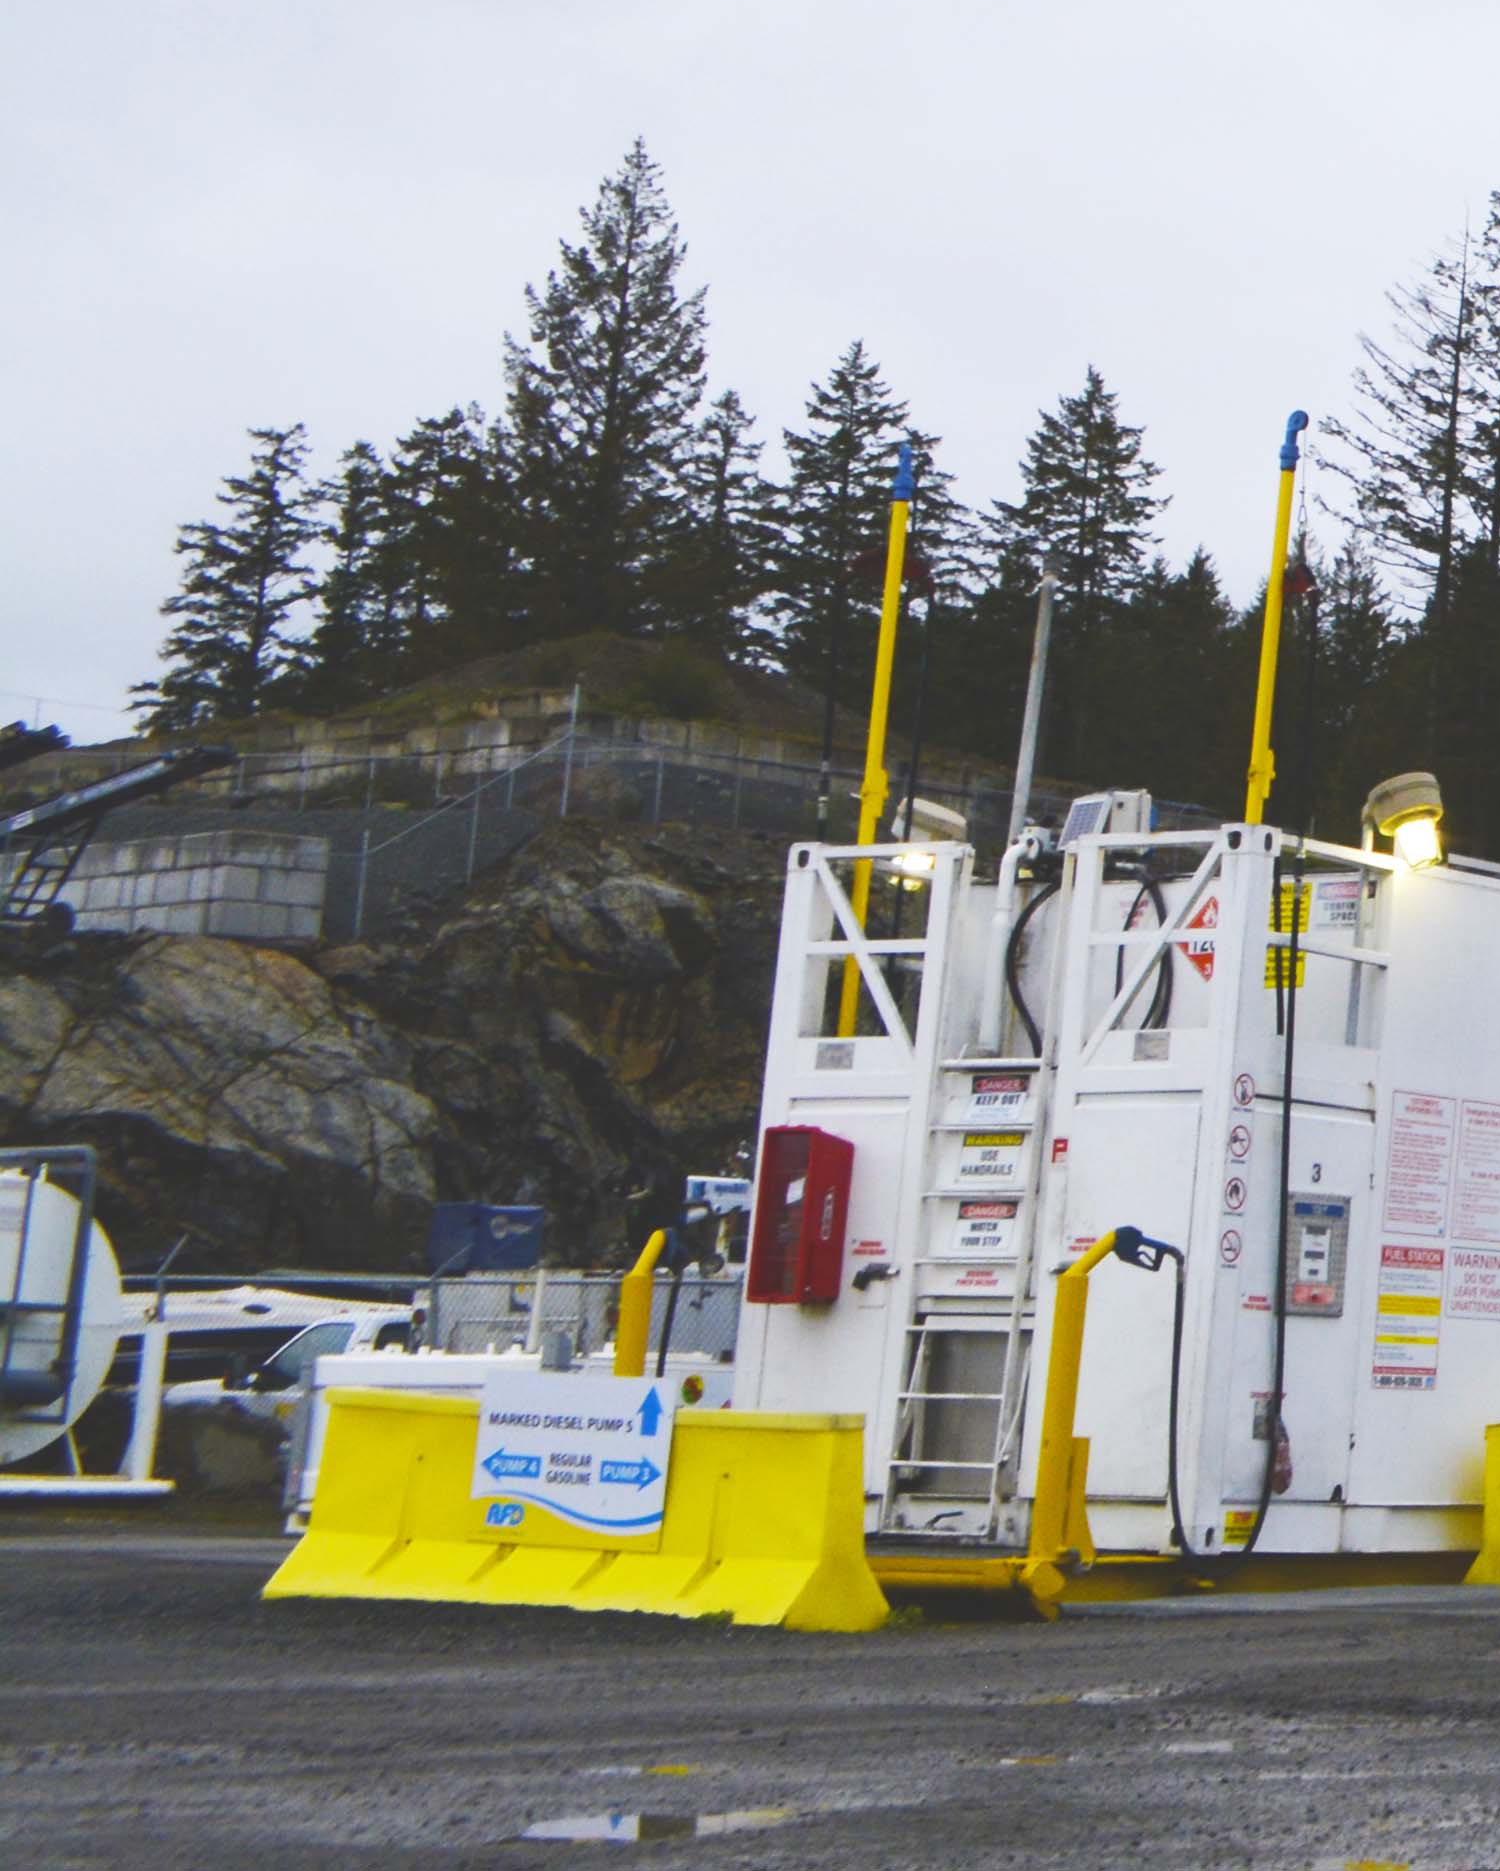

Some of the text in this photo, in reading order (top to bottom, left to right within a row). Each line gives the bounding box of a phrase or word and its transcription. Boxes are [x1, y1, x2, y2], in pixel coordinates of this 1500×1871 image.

[975, 1094, 1021, 1105] KEEP OUT
[980, 1150, 999, 1162] USE
[960, 1164, 1013, 1176] HANDRAILS
[1312, 1163, 1322, 1183] 3
[961, 1236, 1001, 1246] YOUR STEP
[489, 1413, 541, 1428] MARKED
[543, 1415, 584, 1430] DIESEL
[587, 1416, 622, 1432] PUMP
[490, 1459, 538, 1473] PUMP 4
[549, 1453, 592, 1468] REGULAR
[545, 1470, 592, 1485] GASOLINE
[602, 1465, 650, 1480] PUMP 3
[486, 1502, 526, 1527] AFD
